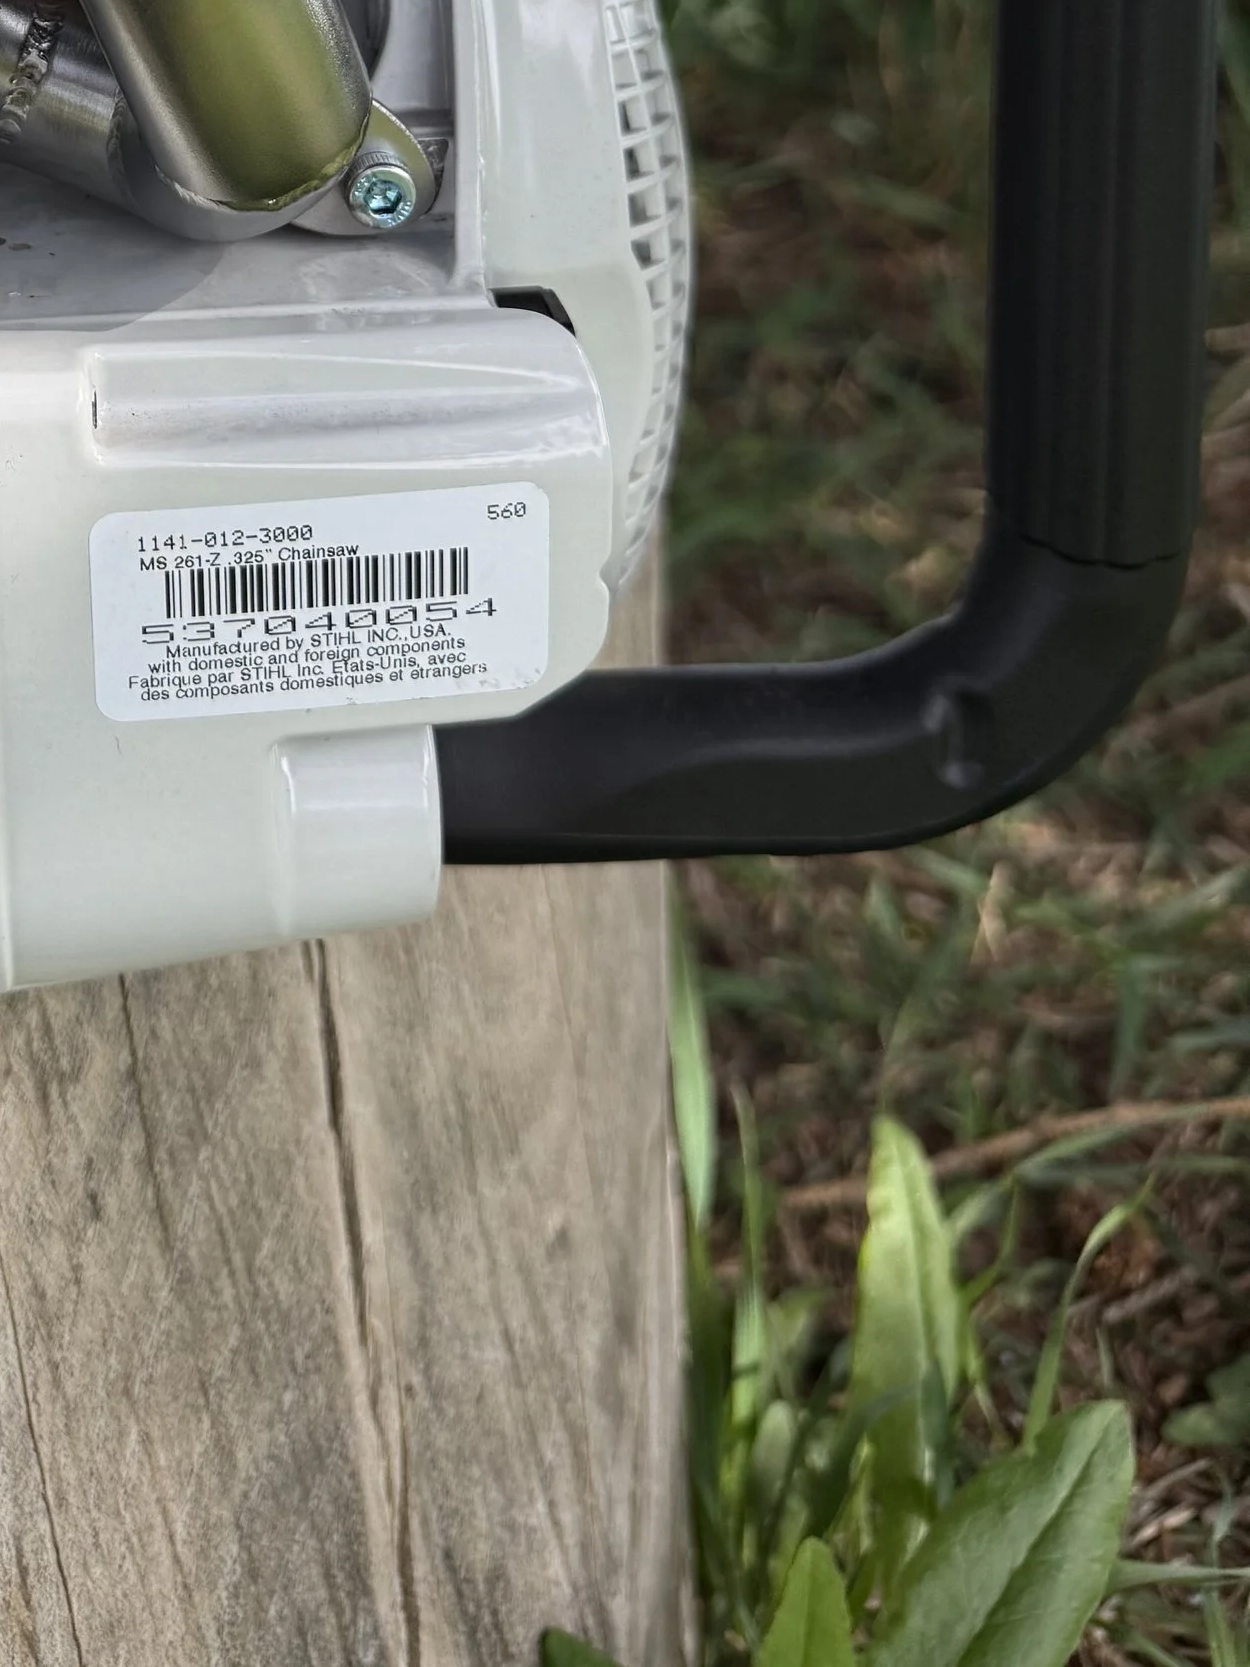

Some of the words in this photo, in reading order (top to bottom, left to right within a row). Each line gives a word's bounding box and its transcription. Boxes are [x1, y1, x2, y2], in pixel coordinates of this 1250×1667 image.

[487, 502, 526, 519] 560
[138, 524, 313, 552] 1141-012-3000
[140, 556, 167, 571] MS
[174, 552, 221, 569] 261-Z
[278, 543, 360, 562] Chainsaw
[141, 598, 497, 644] 537040054
[148, 659, 181, 674] with
[188, 654, 263, 672] domestic
[268, 651, 298, 666] and
[305, 645, 360, 663] foreign
[366, 637, 466, 658] components
[166, 637, 280, 659] Manufactured
[286, 635, 304, 650] by
[311, 631, 361, 648] STIHL
[128, 672, 202, 690] Fabrique
[207, 670, 234, 687] par
[240, 665, 292, 682] STIHL
[428, 651, 466, 666] avec
[141, 687, 170, 702] des
[176, 680, 274, 700] composants
[280, 671, 384, 692] domestiques
[389, 668, 404, 682] et
[410, 662, 488, 681] etrangers
